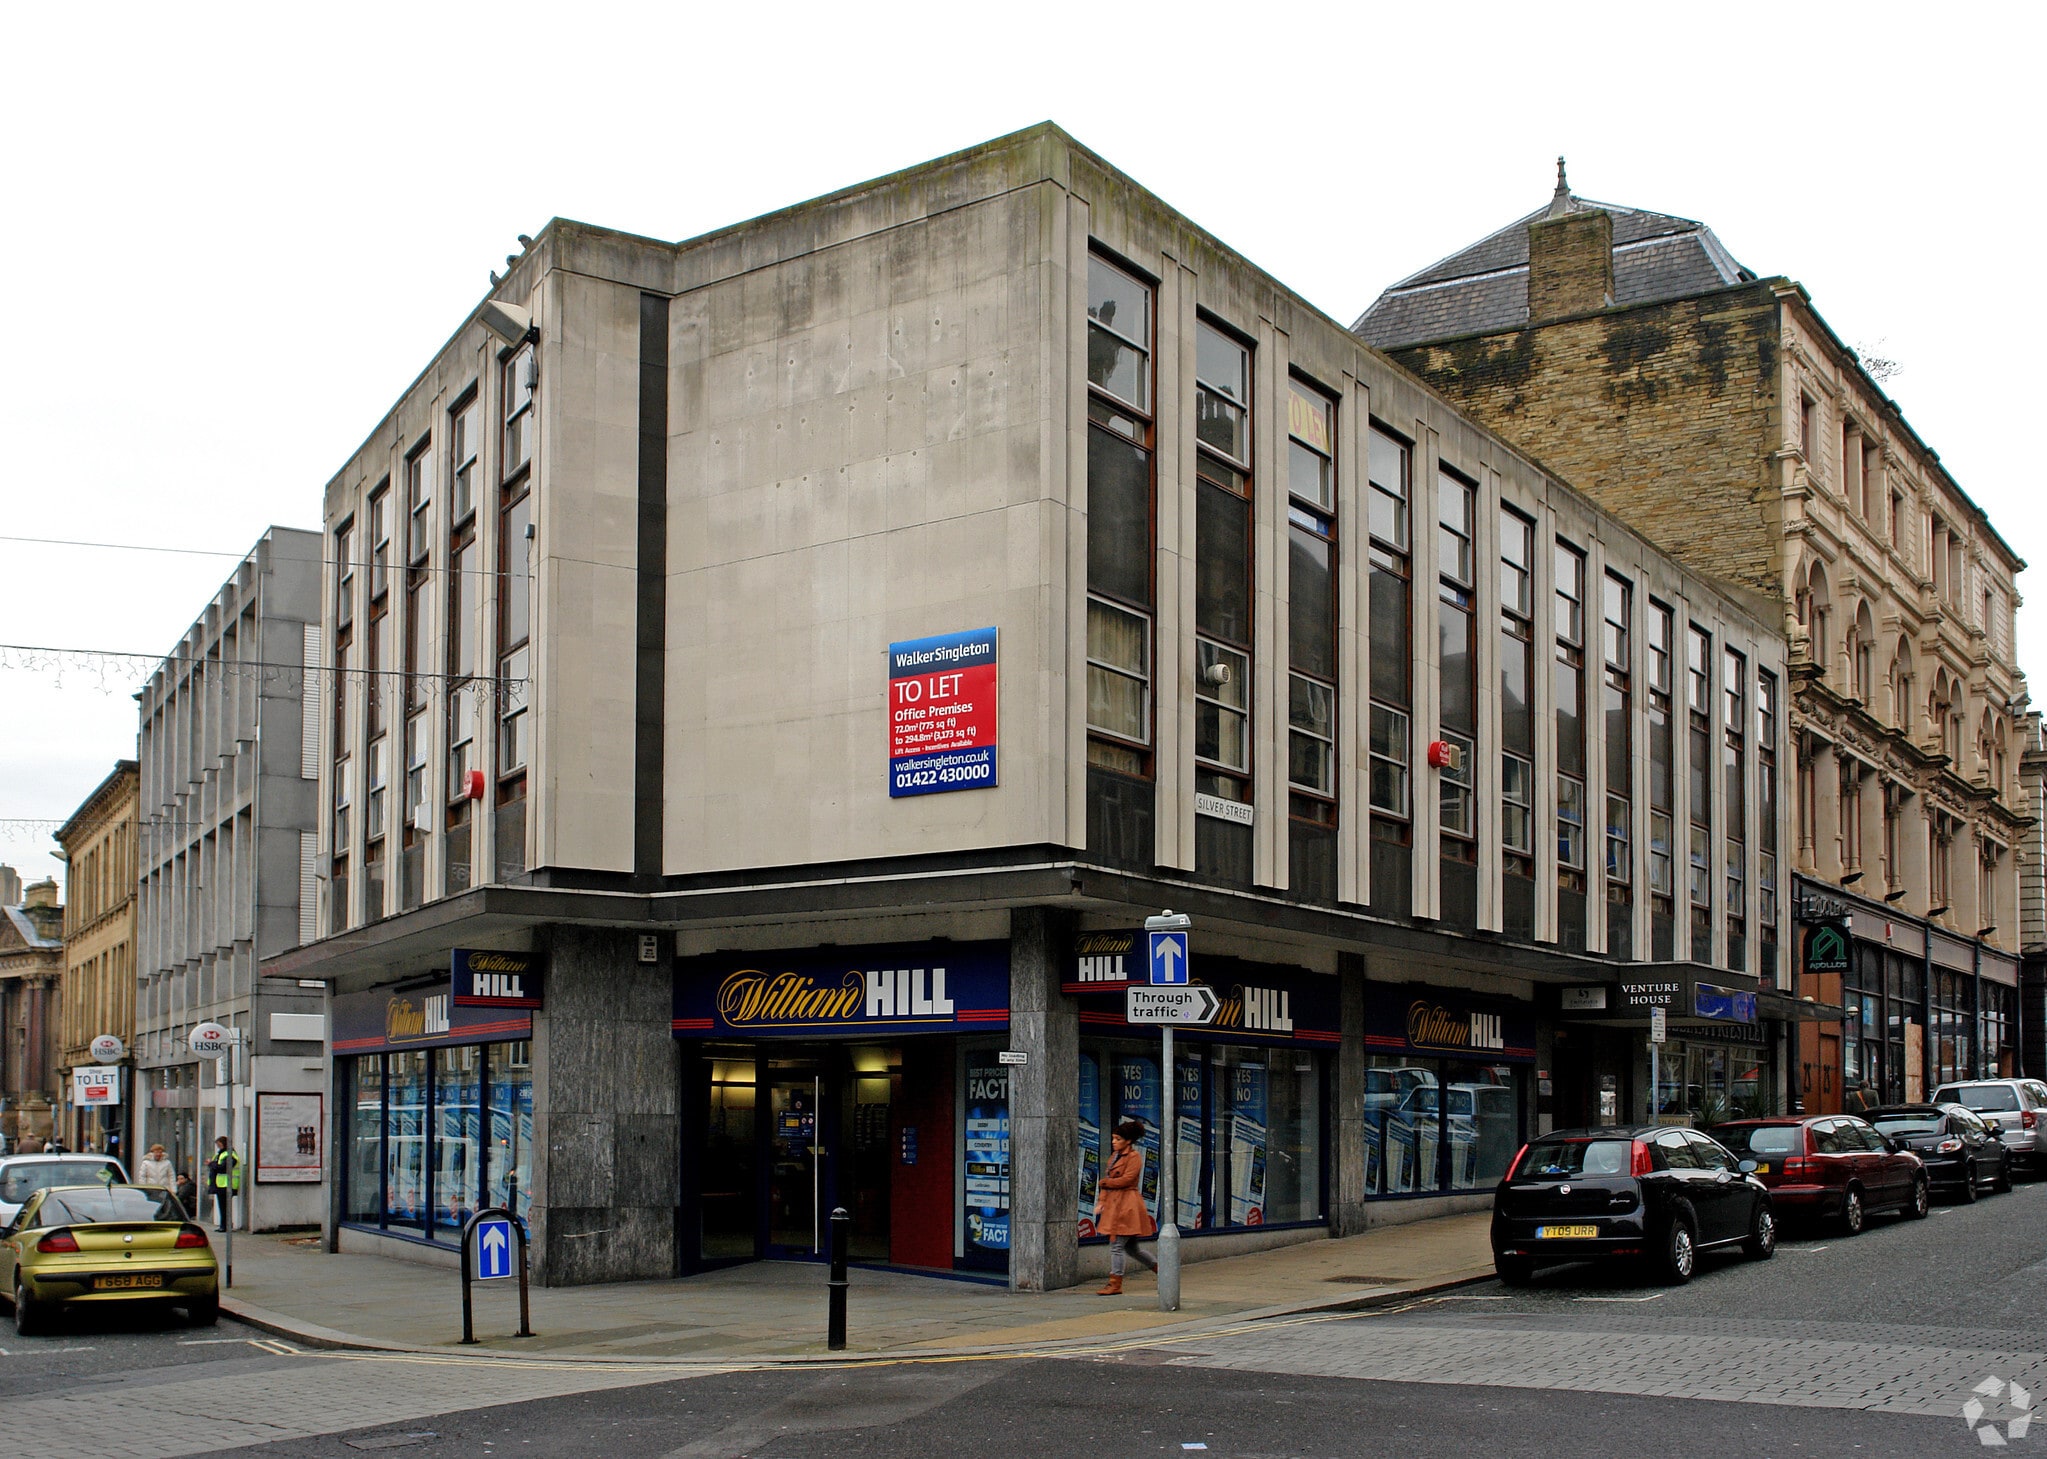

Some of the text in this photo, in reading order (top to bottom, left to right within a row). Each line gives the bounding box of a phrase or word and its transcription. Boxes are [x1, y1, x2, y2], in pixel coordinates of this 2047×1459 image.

[895, 673, 963, 704] TO LET
[895, 702, 973, 722] Office Premises
[936, 721, 945, 730] sq
[946, 717, 957, 728] ft)
[895, 737, 903, 745] to
[956, 730, 965, 739] sq
[967, 726, 977, 736] ft)
[895, 750, 989, 772] walkersingleton.co.uk
[897, 764, 990, 788] 01422 430000
[1198, 797, 1251, 820] SILVER STREET
[1075, 933, 1134, 954] William
[468, 952, 527, 973] William
[1078, 955, 1127, 982] HILL
[473, 973, 524, 998] HILL
[1622, 983, 1680, 994] VENTURE
[717, 968, 954, 1022] William HILL
[1133, 991, 1193, 1007] Through
[1630, 995, 1672, 1005] HOUSE
[424, 994, 450, 1034] HILL
[1133, 1006, 1178, 1018] traffic
[1244, 986, 1293, 1031] HILL
[1408, 1000, 1504, 1049] William HILL
[94, 1047, 120, 1056] HSBC
[195, 1041, 227, 1051] HSBC
[76, 1074, 116, 1086] TO LET
[1124, 1065, 1142, 1081] YES
[1182, 1068, 1199, 1082] YES
[1236, 1070, 1251, 1084] YES
[970, 1079, 1008, 1100] FACT
[1125, 1086, 1142, 1101] NO
[1182, 1087, 1199, 1101] NO
[1236, 1088, 1251, 1102] NO
[983, 1227, 1008, 1243] FACT
[1544, 1225, 1596, 1237] YT09 URR
[135, 1274, 161, 1287] AGG
